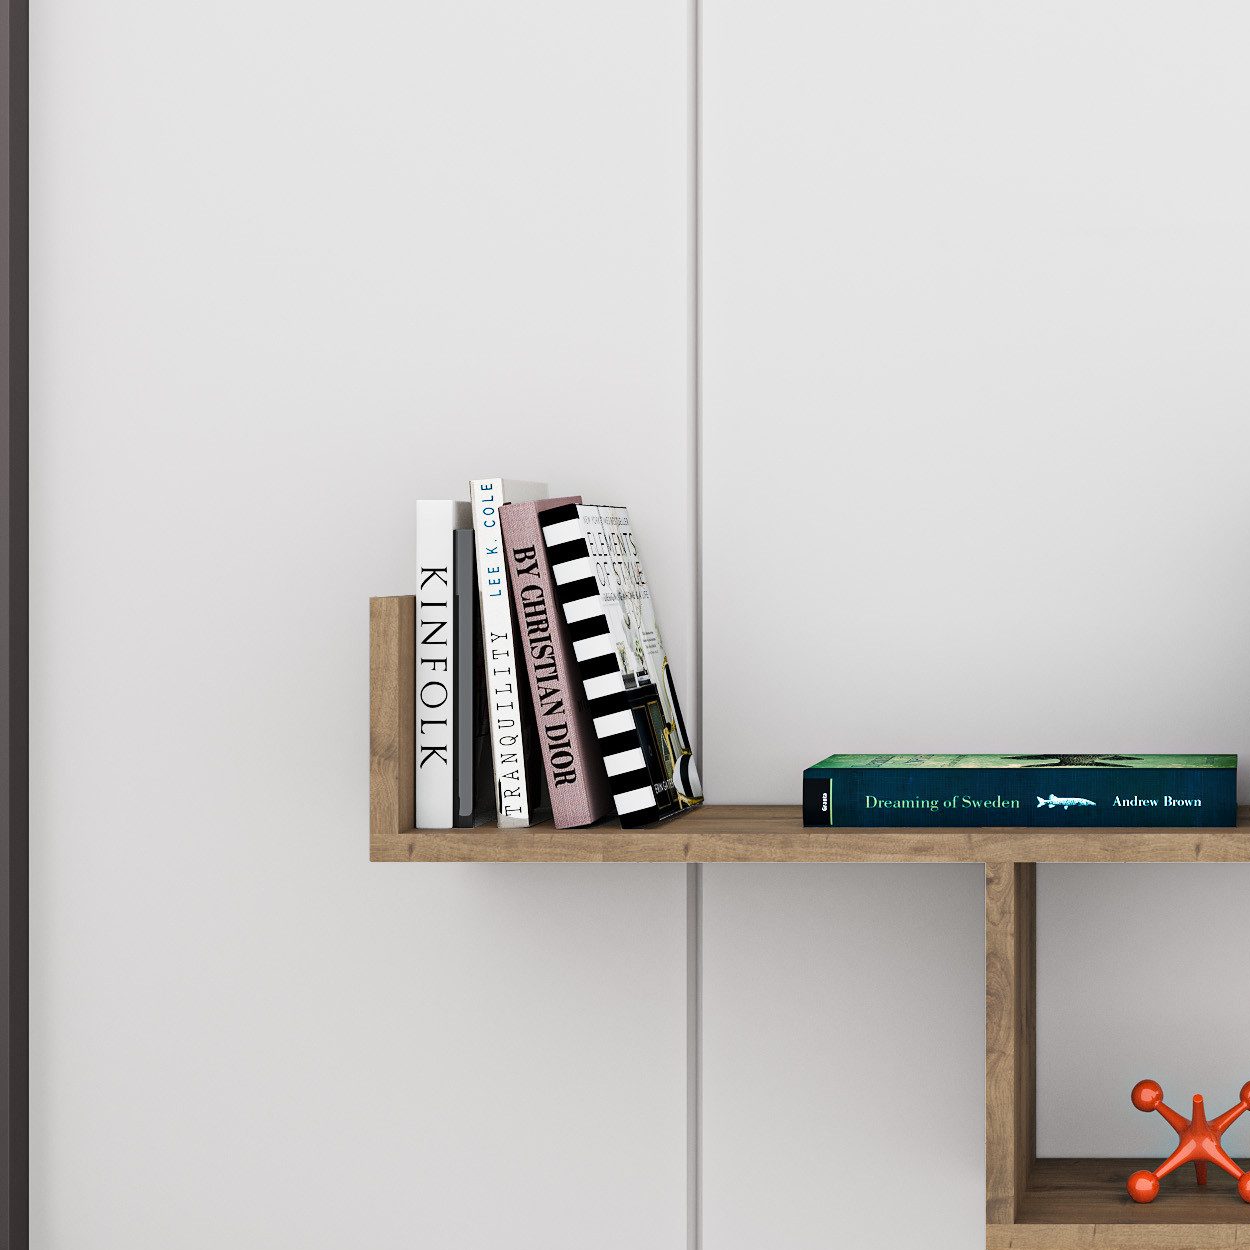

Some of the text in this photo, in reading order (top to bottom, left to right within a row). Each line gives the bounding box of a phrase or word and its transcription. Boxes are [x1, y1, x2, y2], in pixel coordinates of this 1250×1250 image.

[420, 566, 448, 769] KINFOLK
[480, 482, 524, 817] TRANQUILITY LEE K. COLE
[513, 544, 578, 788] BY CHRISTIAN DIOR
[865, 795, 1020, 812] Dreaming of Sweden
[1112, 795, 1202, 807] Andrew Brown
